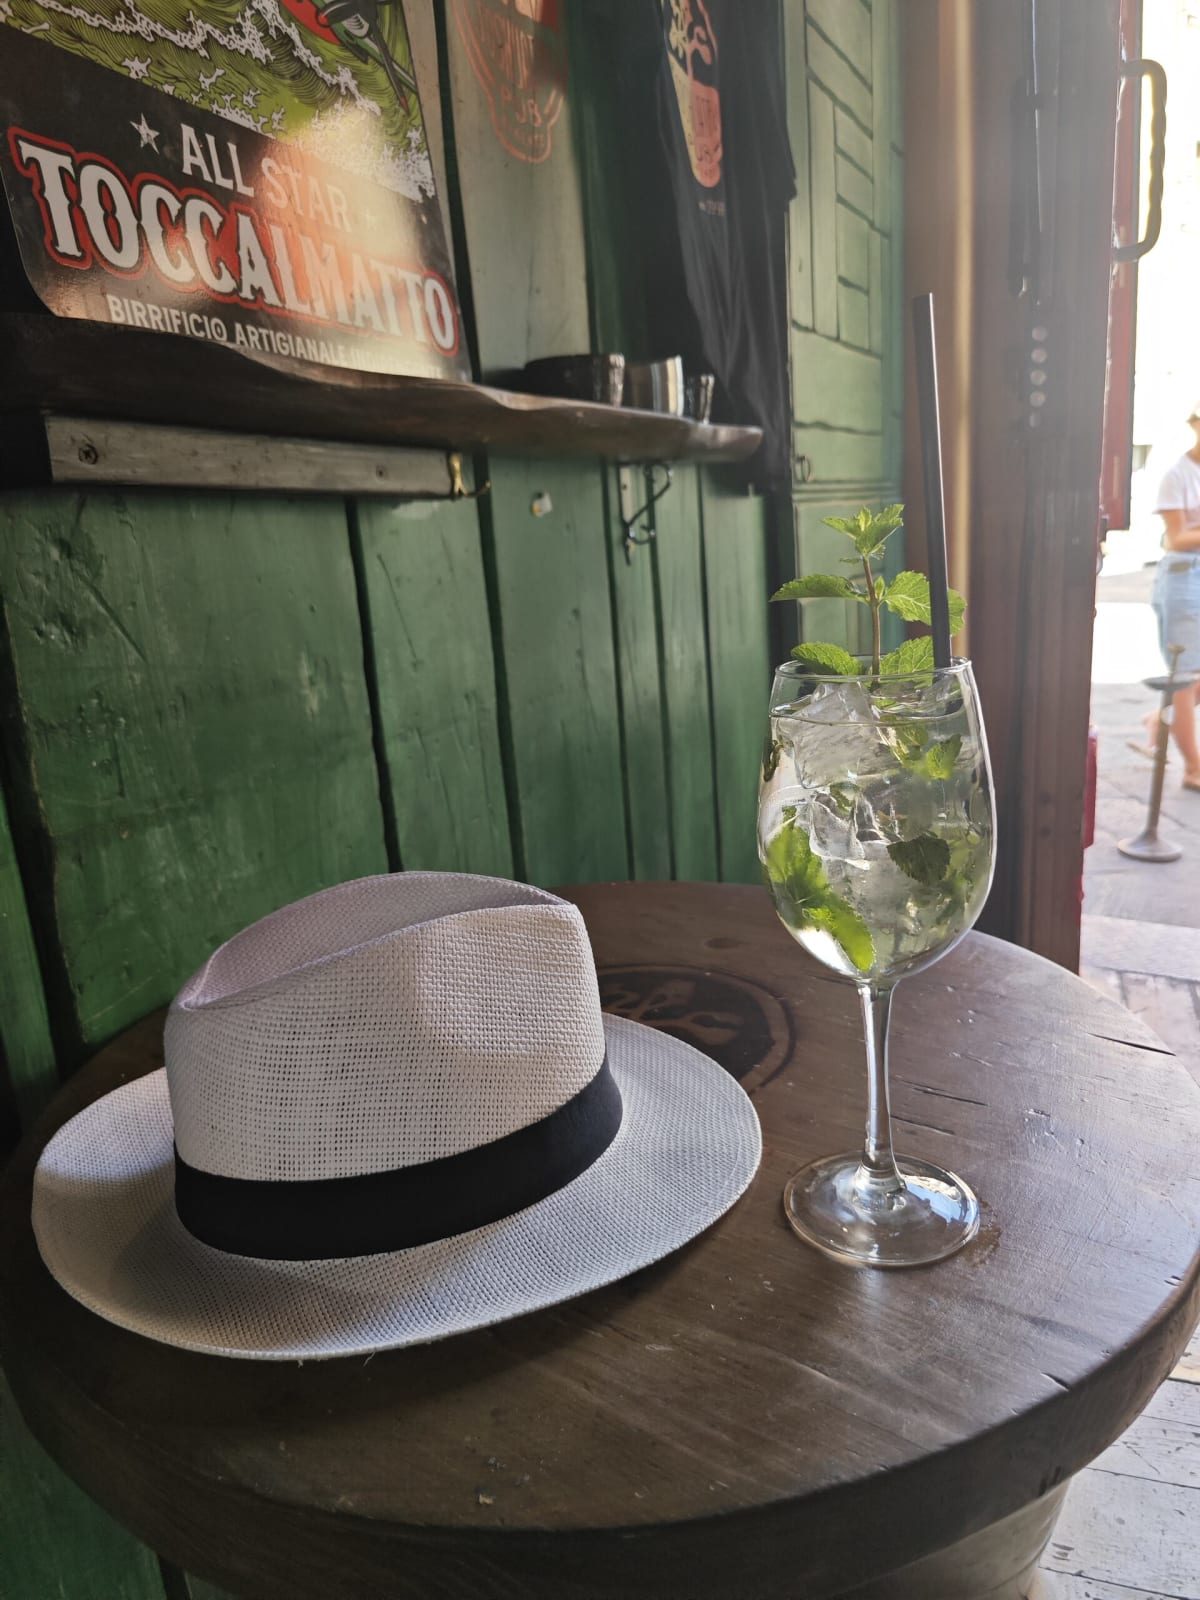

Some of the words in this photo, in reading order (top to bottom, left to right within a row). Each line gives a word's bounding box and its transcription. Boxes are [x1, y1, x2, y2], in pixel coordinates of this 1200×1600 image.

[180, 123, 255, 198] ALL
[261, 157, 352, 233] STAR
[18, 139, 456, 351] TOCCALMATTO
[106, 293, 228, 343] BIRRIFICIO
[234, 322, 346, 367] ARTIGIANALE
